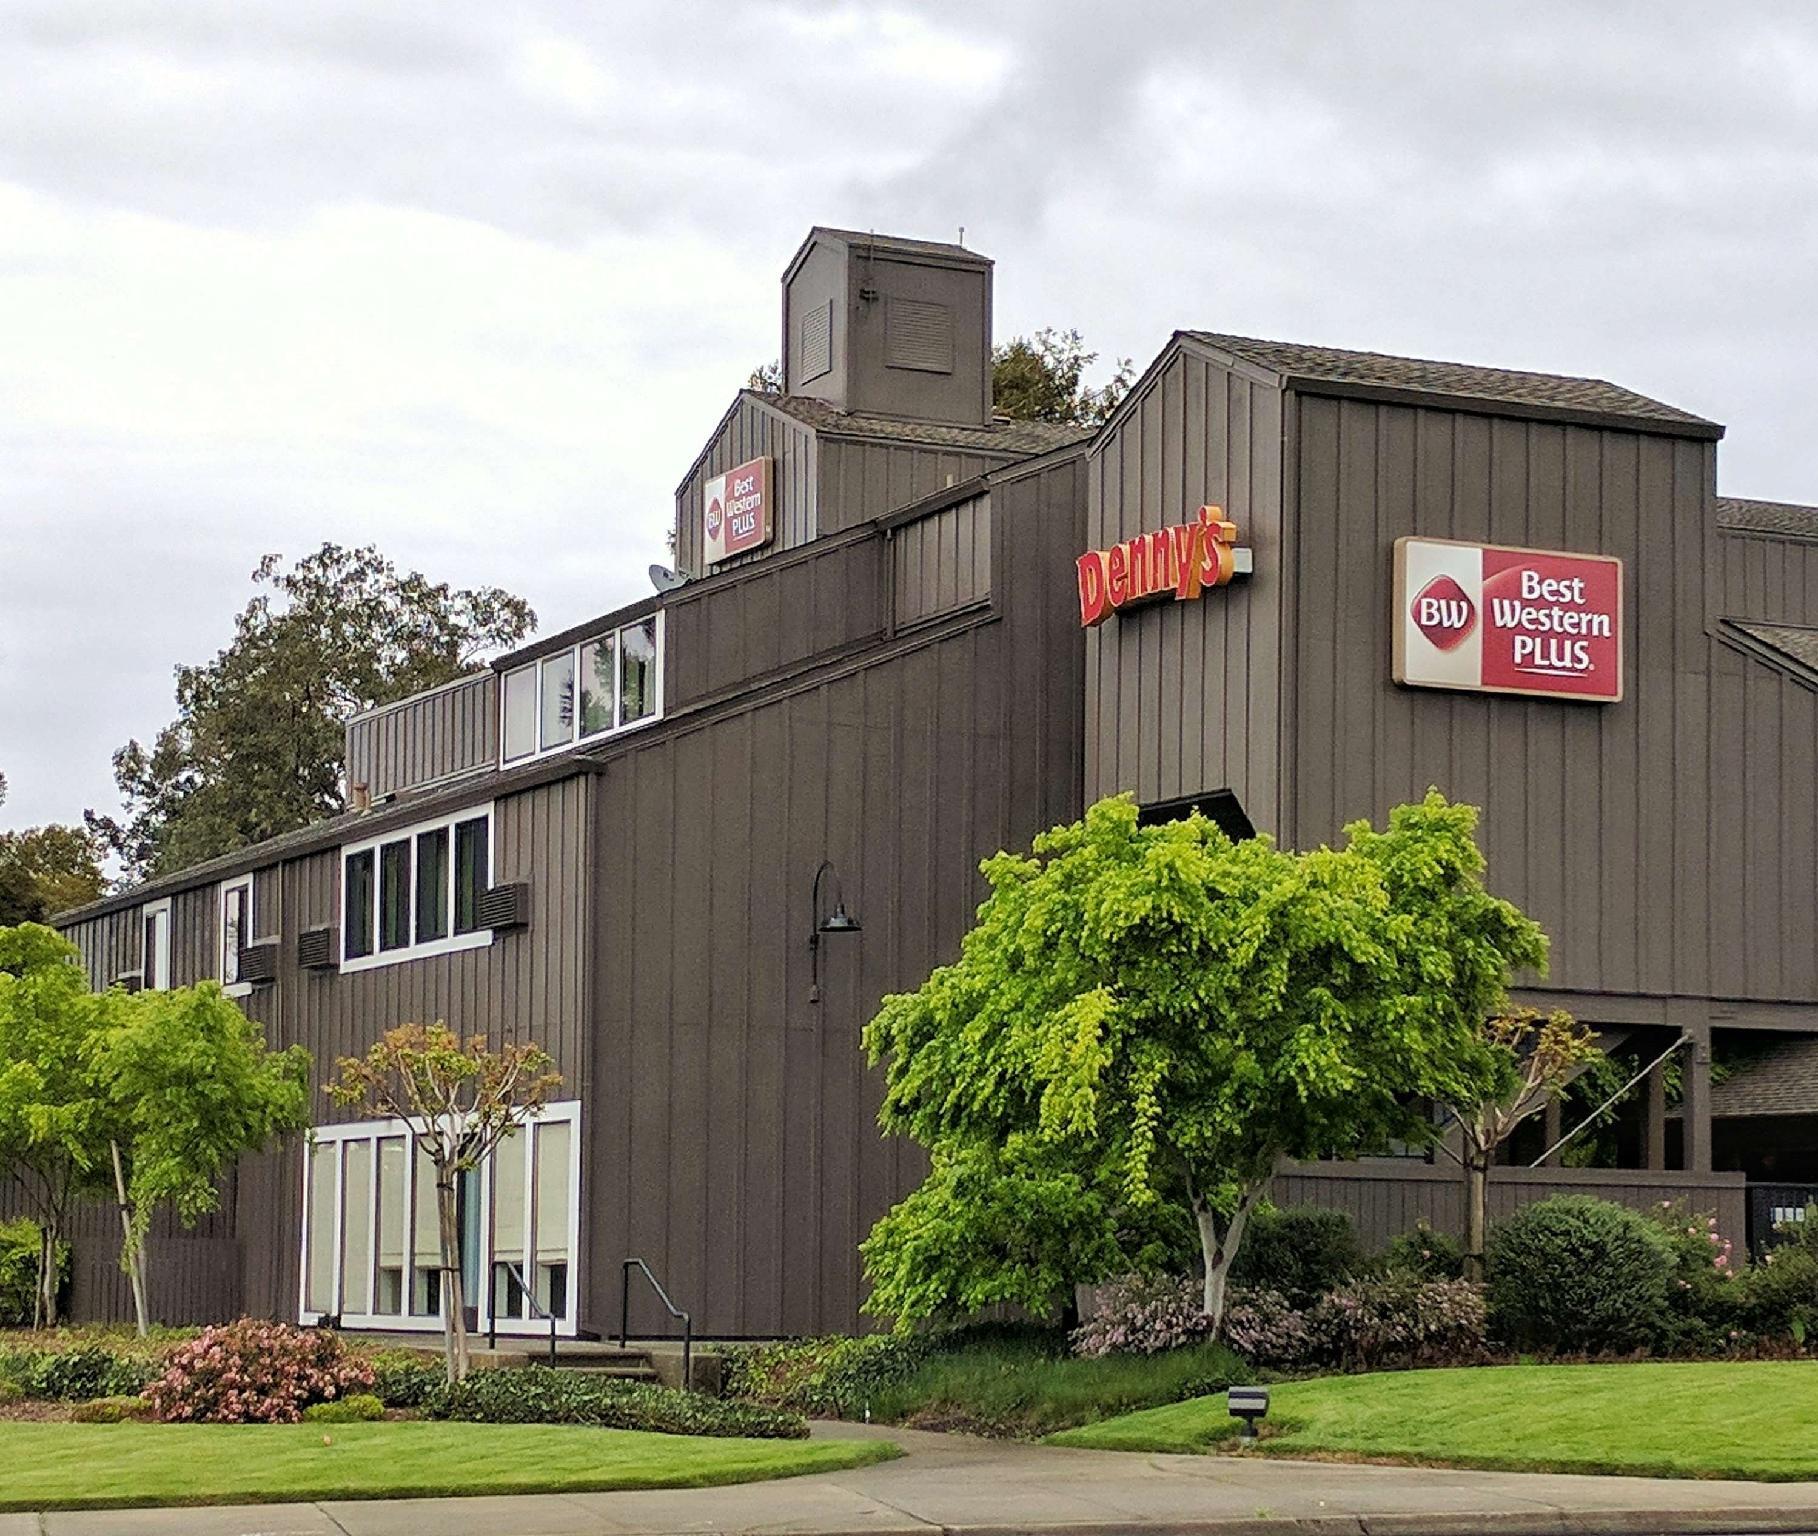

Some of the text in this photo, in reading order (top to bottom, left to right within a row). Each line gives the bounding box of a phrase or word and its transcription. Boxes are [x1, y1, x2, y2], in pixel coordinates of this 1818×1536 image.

[734, 476, 753, 497] Best
[726, 492, 761, 517] Western
[732, 512, 754, 536] PLUS
[1076, 505, 1222, 628] Denny's
[1521, 570, 1585, 604] Best
[1420, 598, 1468, 629] BW
[1492, 598, 1612, 637] Western
[1514, 635, 1590, 670] PLUS
